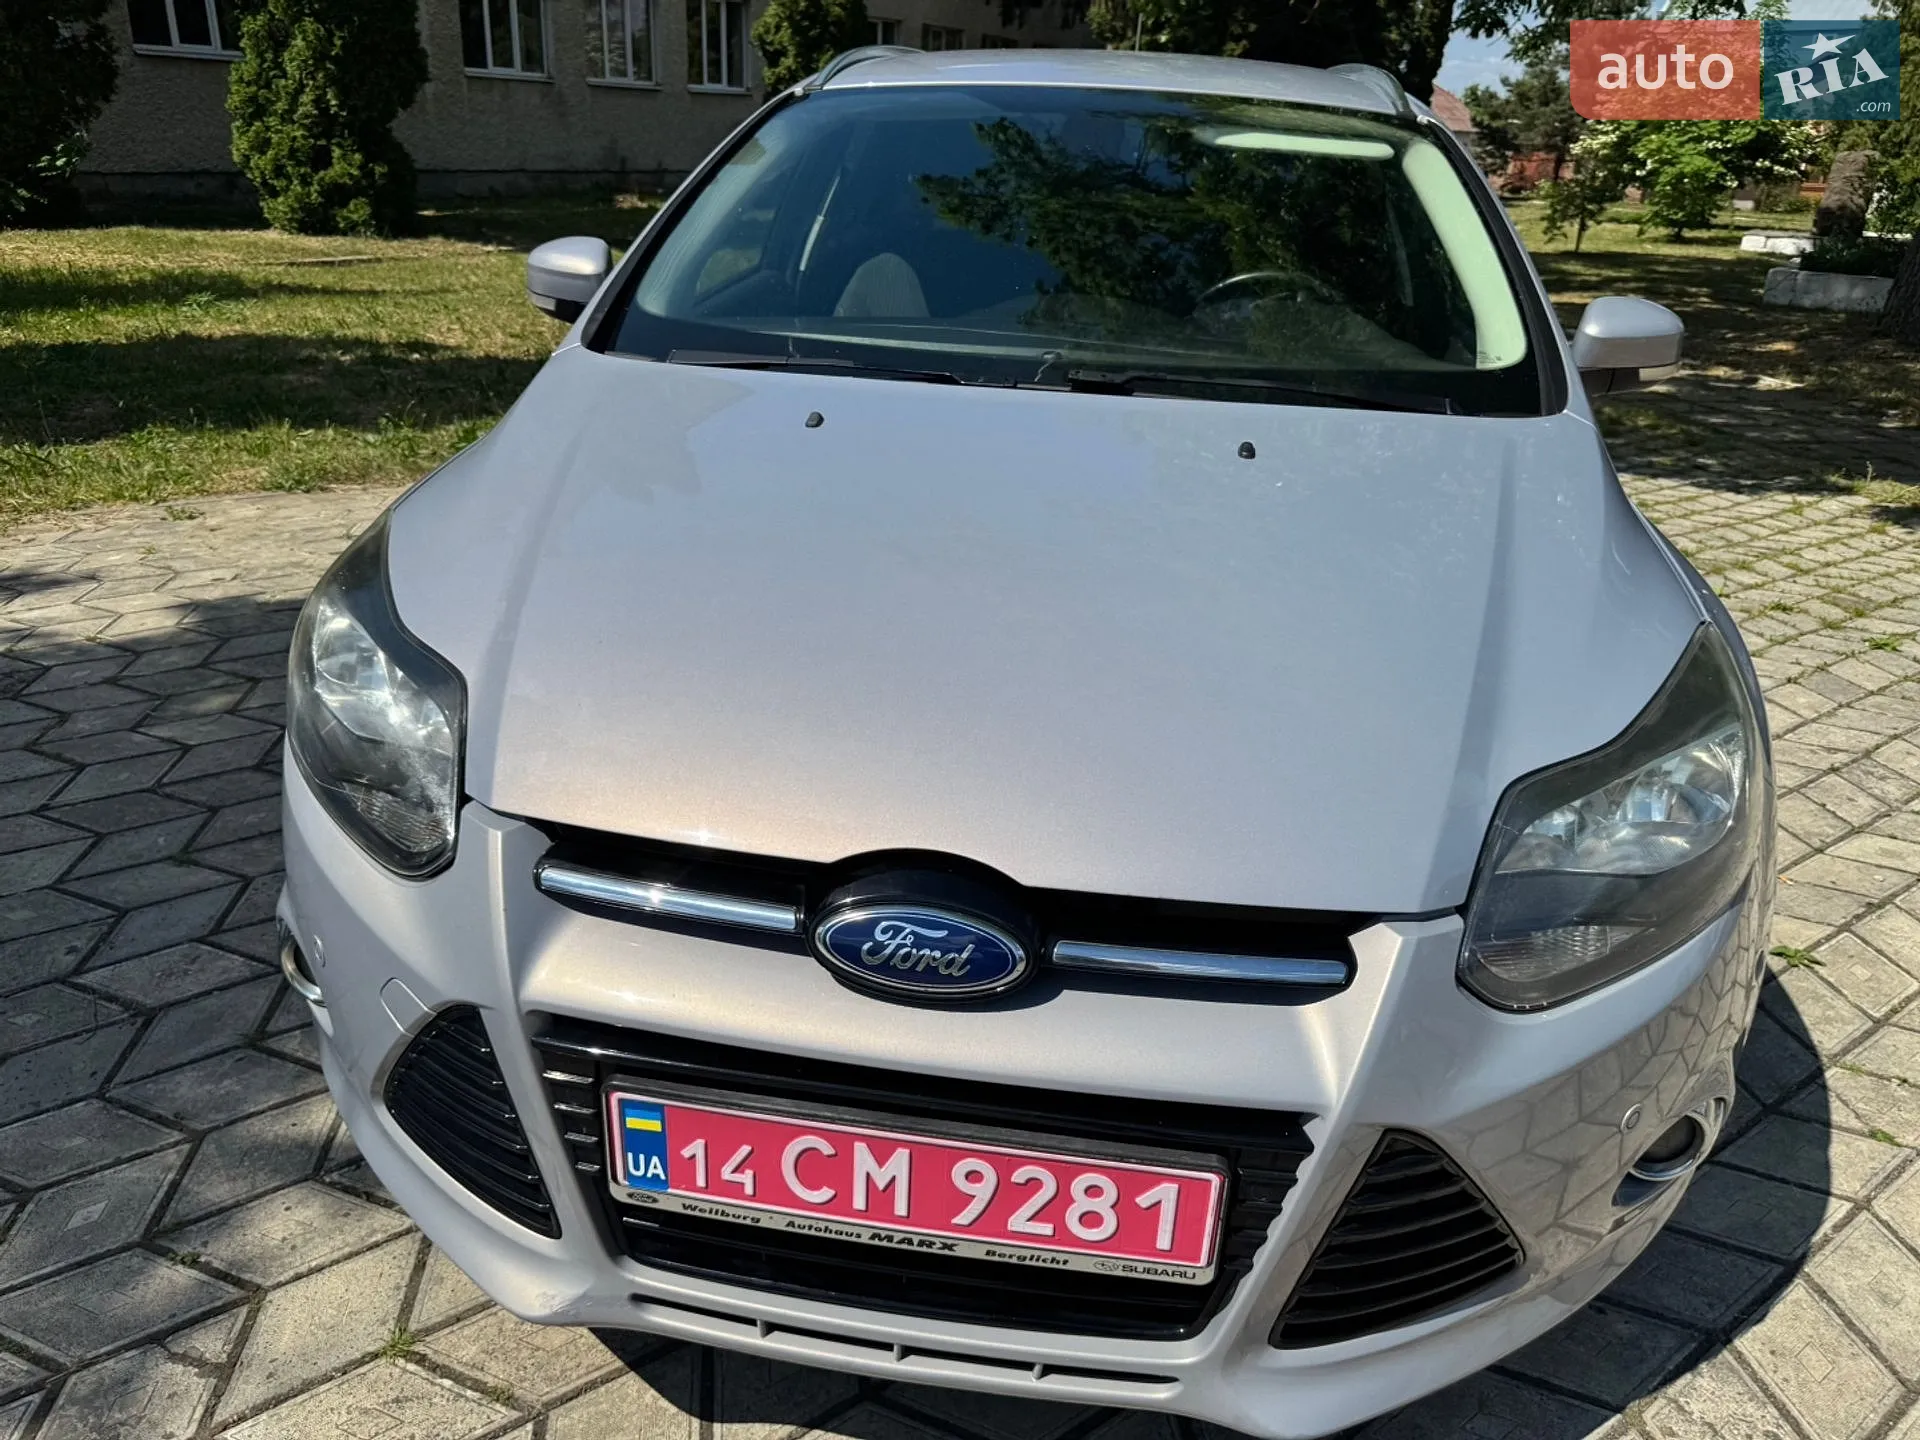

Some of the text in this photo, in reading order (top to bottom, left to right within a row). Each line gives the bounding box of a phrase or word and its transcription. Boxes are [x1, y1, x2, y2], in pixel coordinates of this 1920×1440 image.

[861, 921, 975, 977] Ford
[627, 1152, 666, 1180] UA
[680, 1135, 1179, 1251] 14 CM 9281
[785, 1220, 862, 1239] Autohaus
[868, 1231, 959, 1252] MARX
[1121, 1264, 1197, 1280] SUBARU
